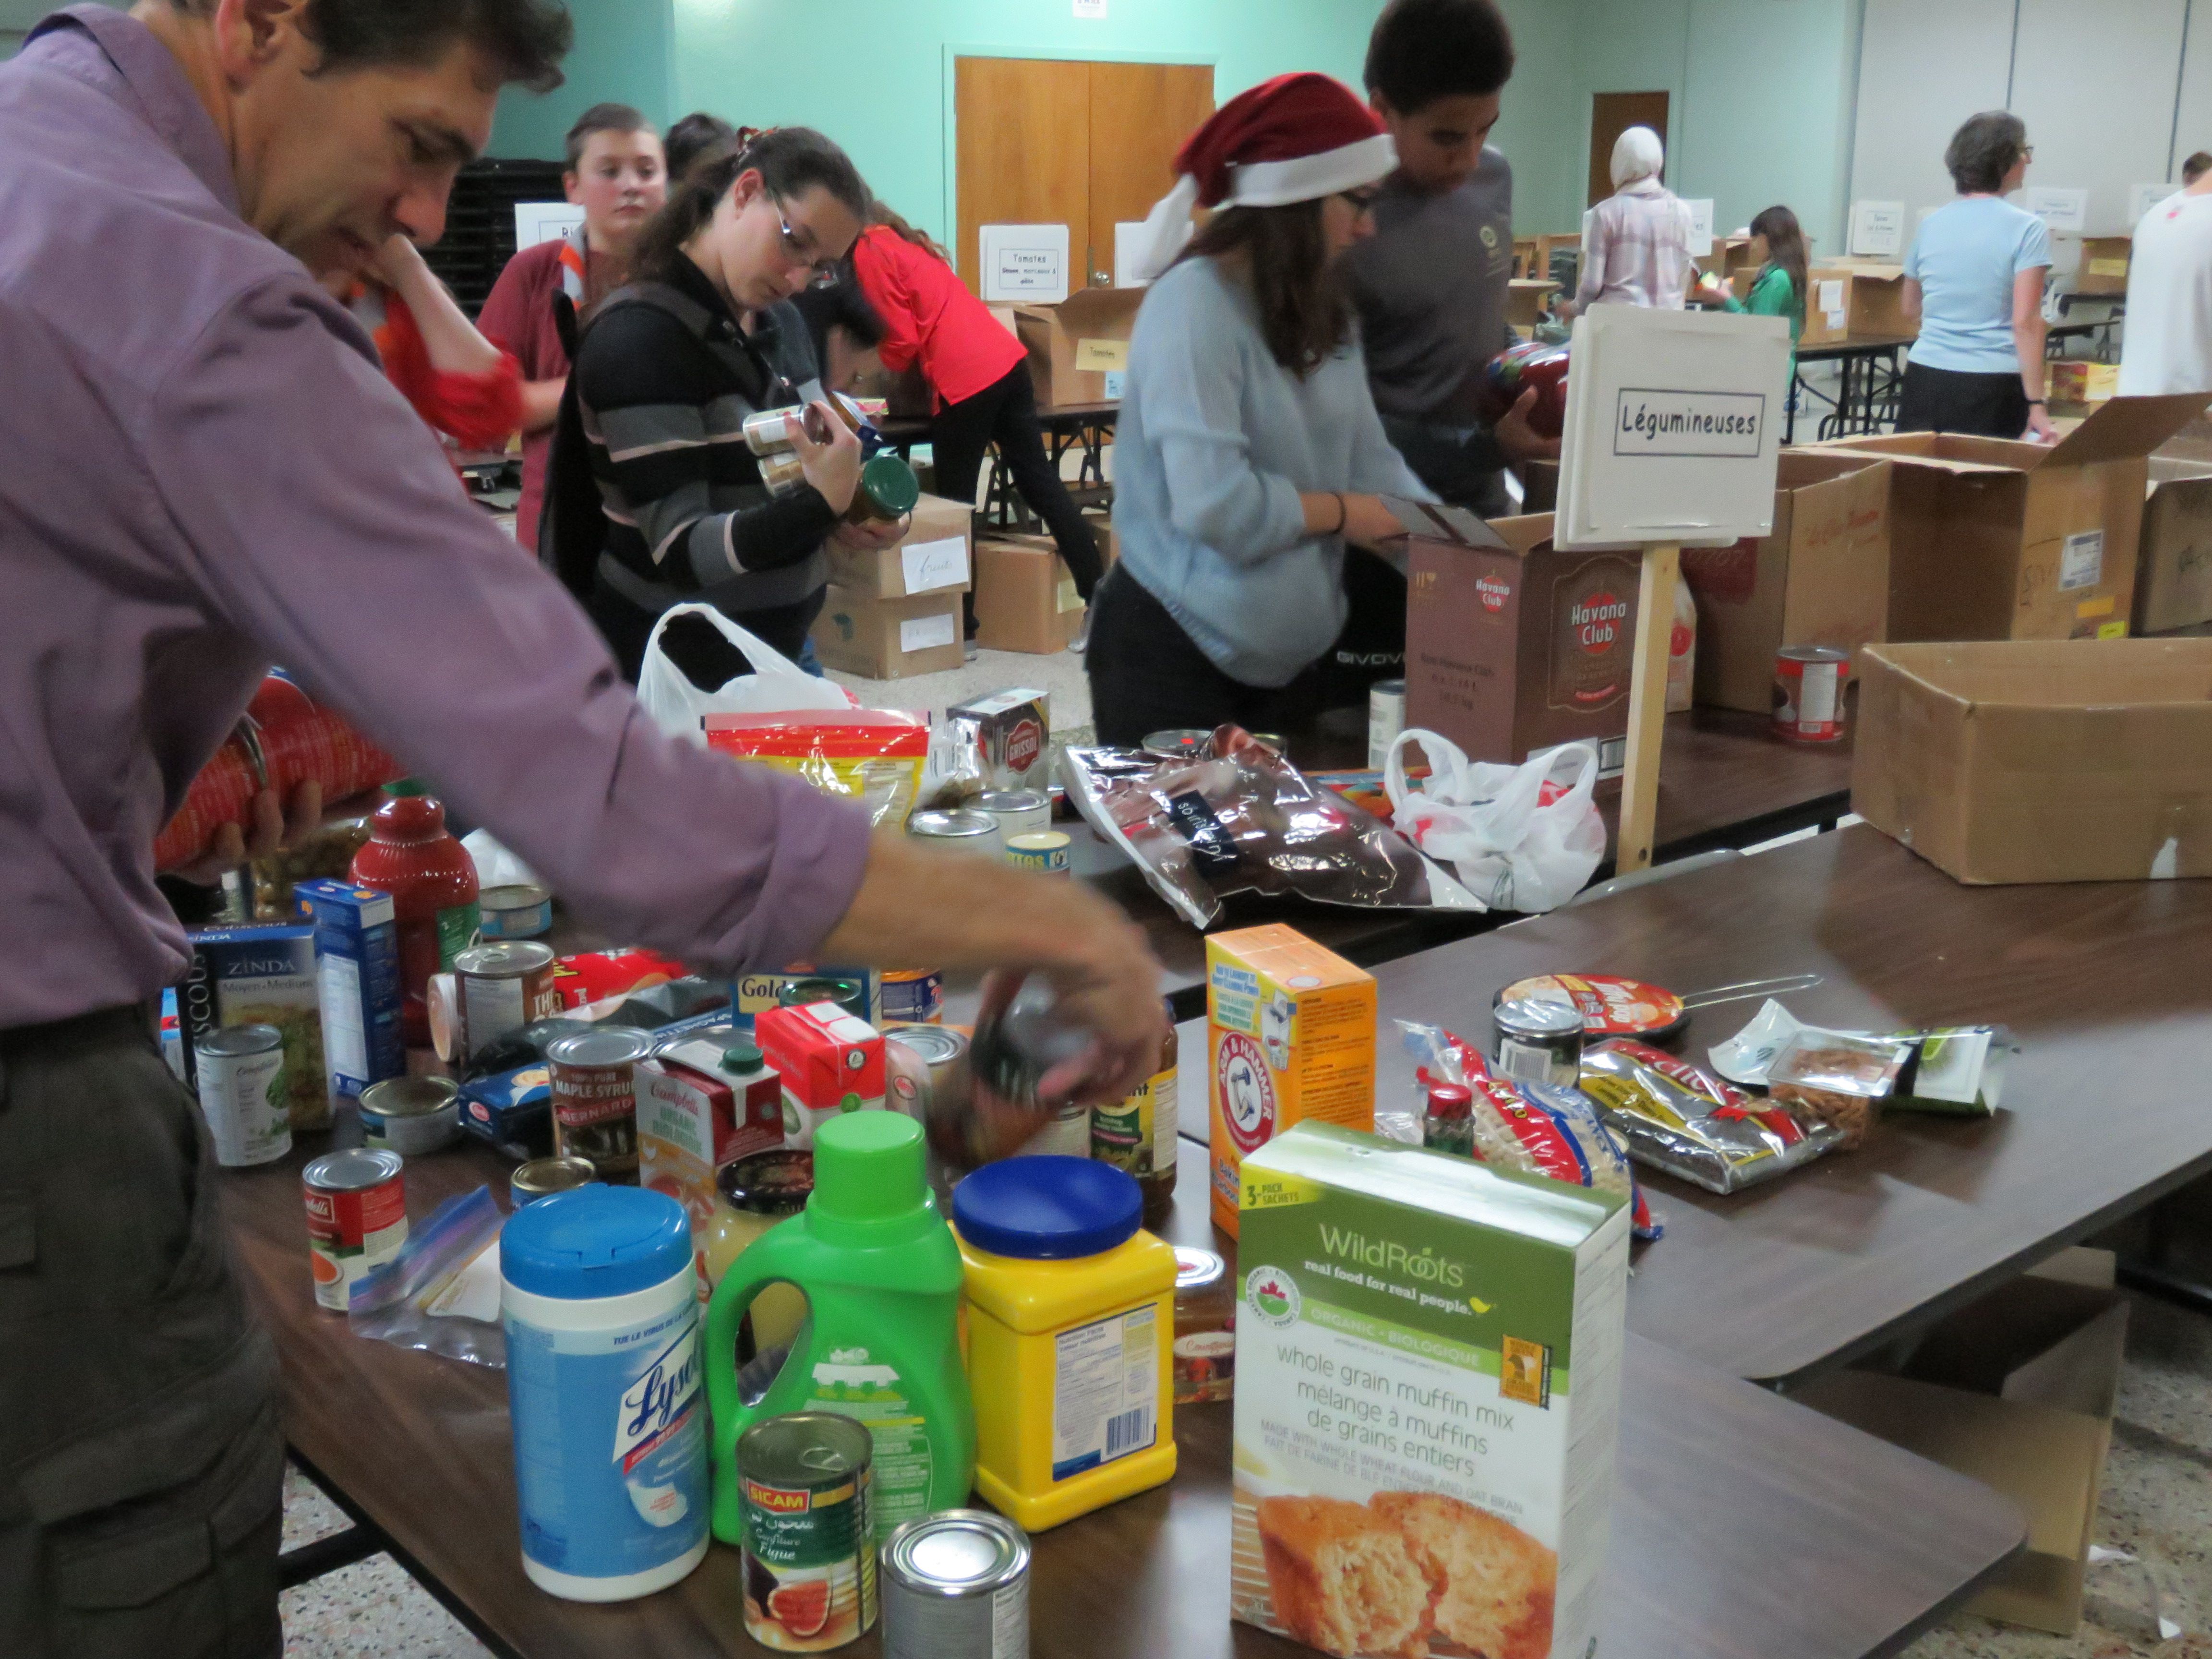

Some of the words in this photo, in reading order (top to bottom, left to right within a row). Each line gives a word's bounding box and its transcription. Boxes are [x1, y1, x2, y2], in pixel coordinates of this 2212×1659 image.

[1013, 254, 1046, 263] Tomates
[1622, 403, 1755, 440] Légumineuses
[1476, 578, 1511, 596] Havana
[1482, 593, 1502, 607] Club
[1571, 602, 1626, 625] Havana
[1582, 623, 1613, 645] Club
[1337, 651, 1406, 665] GIVOV
[1010, 736, 1037, 761] GRISSOL
[228, 960, 296, 975] ZINDA
[555, 1080, 592, 1099] MAPLE
[1240, 1039, 1273, 1120] HAMMER
[561, 1098, 633, 1122] BERNARD
[1262, 1182, 1283, 1193] PACK
[1262, 1192, 1299, 1205] SACHETS
[1318, 1222, 1464, 1288] WildRoots
[1303, 1259, 1332, 1277] real
[1334, 1266, 1364, 1286] food
[1365, 1275, 1386, 1292] for
[1387, 1284, 1417, 1300] real
[1419, 1292, 1473, 1316] people.
[631, 1331, 641, 1342] LE
[643, 1322, 665, 1338] VIRUS
[1310, 1306, 1376, 1336] ORGANIC
[1387, 1329, 1480, 1368] BIOLOGIQUE
[1277, 1344, 1334, 1377] whole
[1340, 1366, 1390, 1395] grain
[1397, 1382, 1468, 1418] muffin
[1476, 1405, 1515, 1431] mix
[1298, 1381, 1382, 1422] mélange
[1388, 1406, 1399, 1428] à
[1406, 1414, 1488, 1455] muffins
[1307, 1407, 1332, 1432] de
[1338, 1420, 1397, 1453] grains
[1403, 1440, 1475, 1478] entiers
[1261, 1419, 1289, 1438] MADE
[1292, 1431, 1318, 1448] WITH
[1321, 1441, 1357, 1462] WHOLE
[1360, 1453, 1396, 1474] WHEAT
[1400, 1465, 1435, 1486] FLOUR
[1437, 1479, 1463, 1497] AND
[1466, 1487, 1487, 1503] OAT
[1490, 1494, 1524, 1514] BRAN
[1264, 1434, 1285, 1450] FAIT
[1288, 1442, 1300, 1456] DE
[1304, 1449, 1339, 1469] FARINE
[1344, 1462, 1357, 1477] DE
[750, 1486, 804, 1508] SICAM
